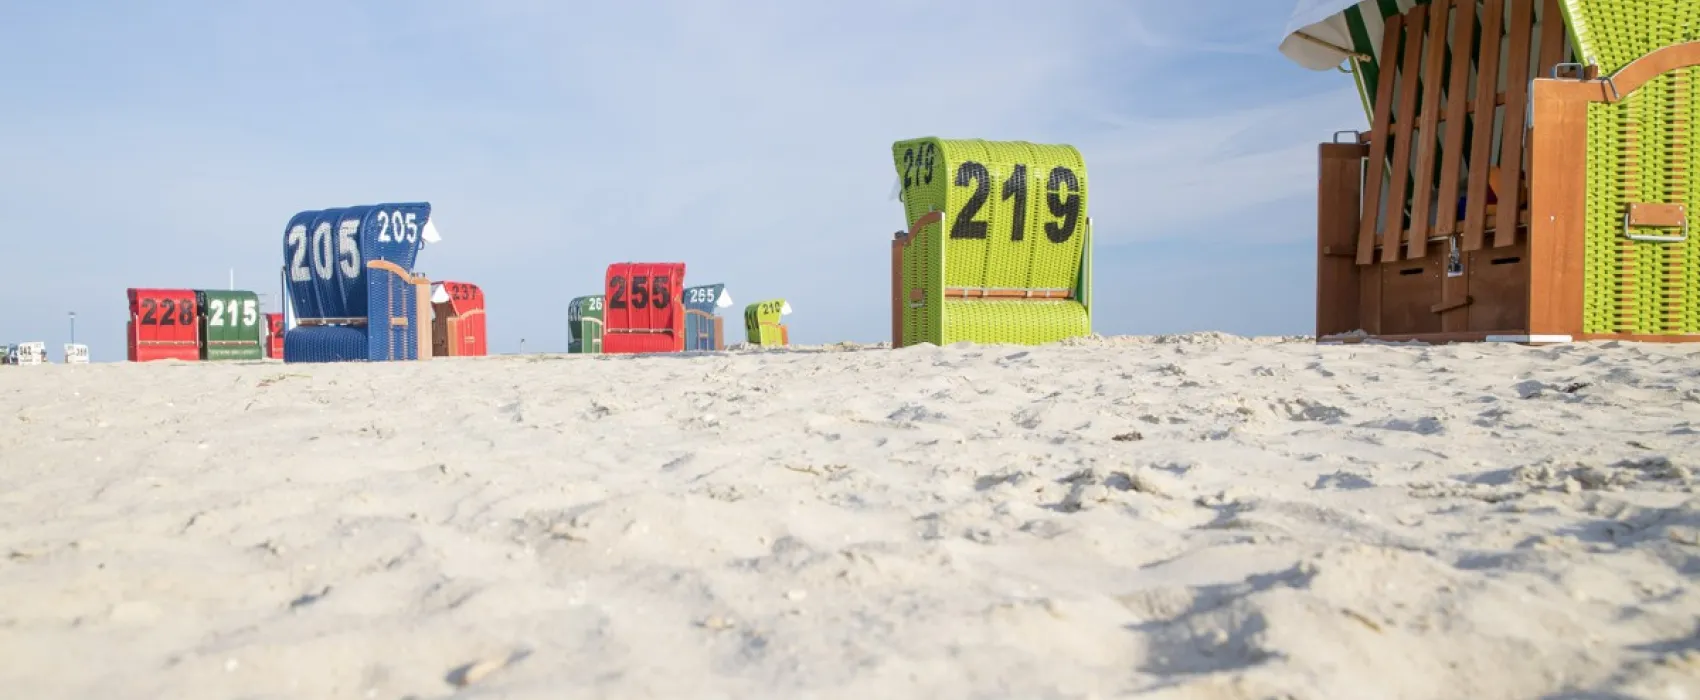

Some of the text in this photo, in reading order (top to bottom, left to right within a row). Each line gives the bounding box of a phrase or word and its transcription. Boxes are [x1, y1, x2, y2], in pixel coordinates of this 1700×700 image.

[902, 142, 935, 190] 219
[951, 160, 1080, 243] 219
[377, 210, 418, 243] 205
[288, 219, 361, 282] 205
[452, 284, 478, 300] 237
[609, 275, 671, 309] 255
[689, 288, 715, 303] 265
[140, 298, 194, 326] 228
[209, 299, 258, 327] 215
